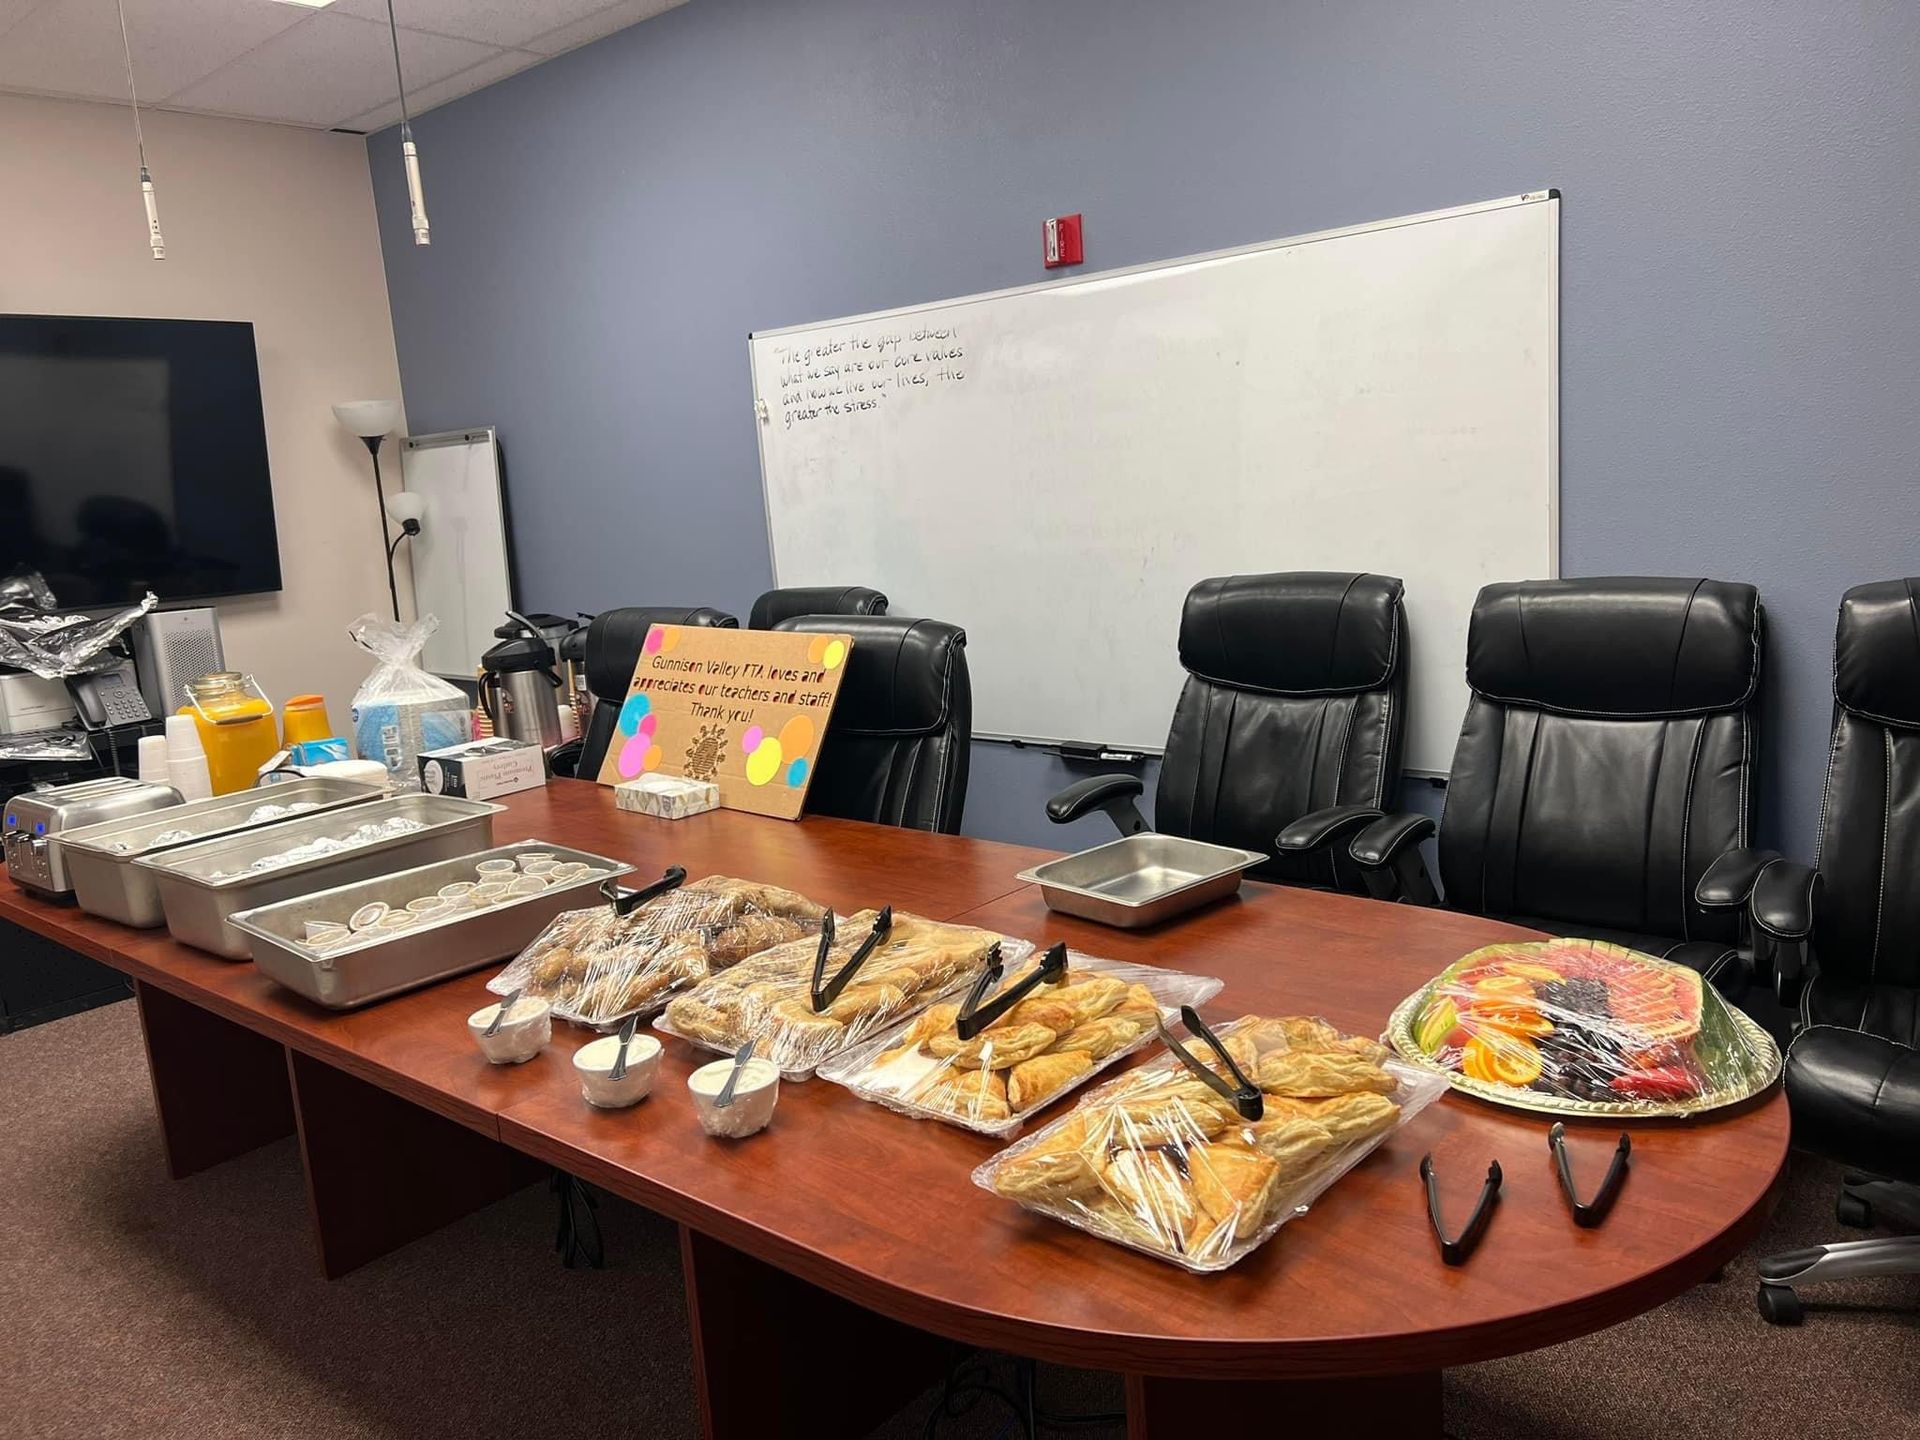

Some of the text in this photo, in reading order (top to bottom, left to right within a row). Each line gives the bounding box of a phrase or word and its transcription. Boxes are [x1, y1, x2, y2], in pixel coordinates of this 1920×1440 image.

[804, 339, 846, 366] greater
[849, 334, 872, 351] the
[877, 335, 901, 352] gap
[824, 366, 840, 380] say
[844, 362, 864, 373] are
[868, 359, 889, 370] our
[845, 380, 865, 394] live
[872, 377, 892, 389] our
[937, 365, 965, 381] the
[785, 404, 822, 430] greater
[824, 403, 840, 415] the
[652, 655, 703, 673] Gunnison
[707, 660, 740, 679] Valley
[767, 664, 799, 681] loves
[801, 668, 827, 683] and
[633, 676, 833, 708] appreciates our teachers and staff!
[691, 701, 754, 724] Thank you!
